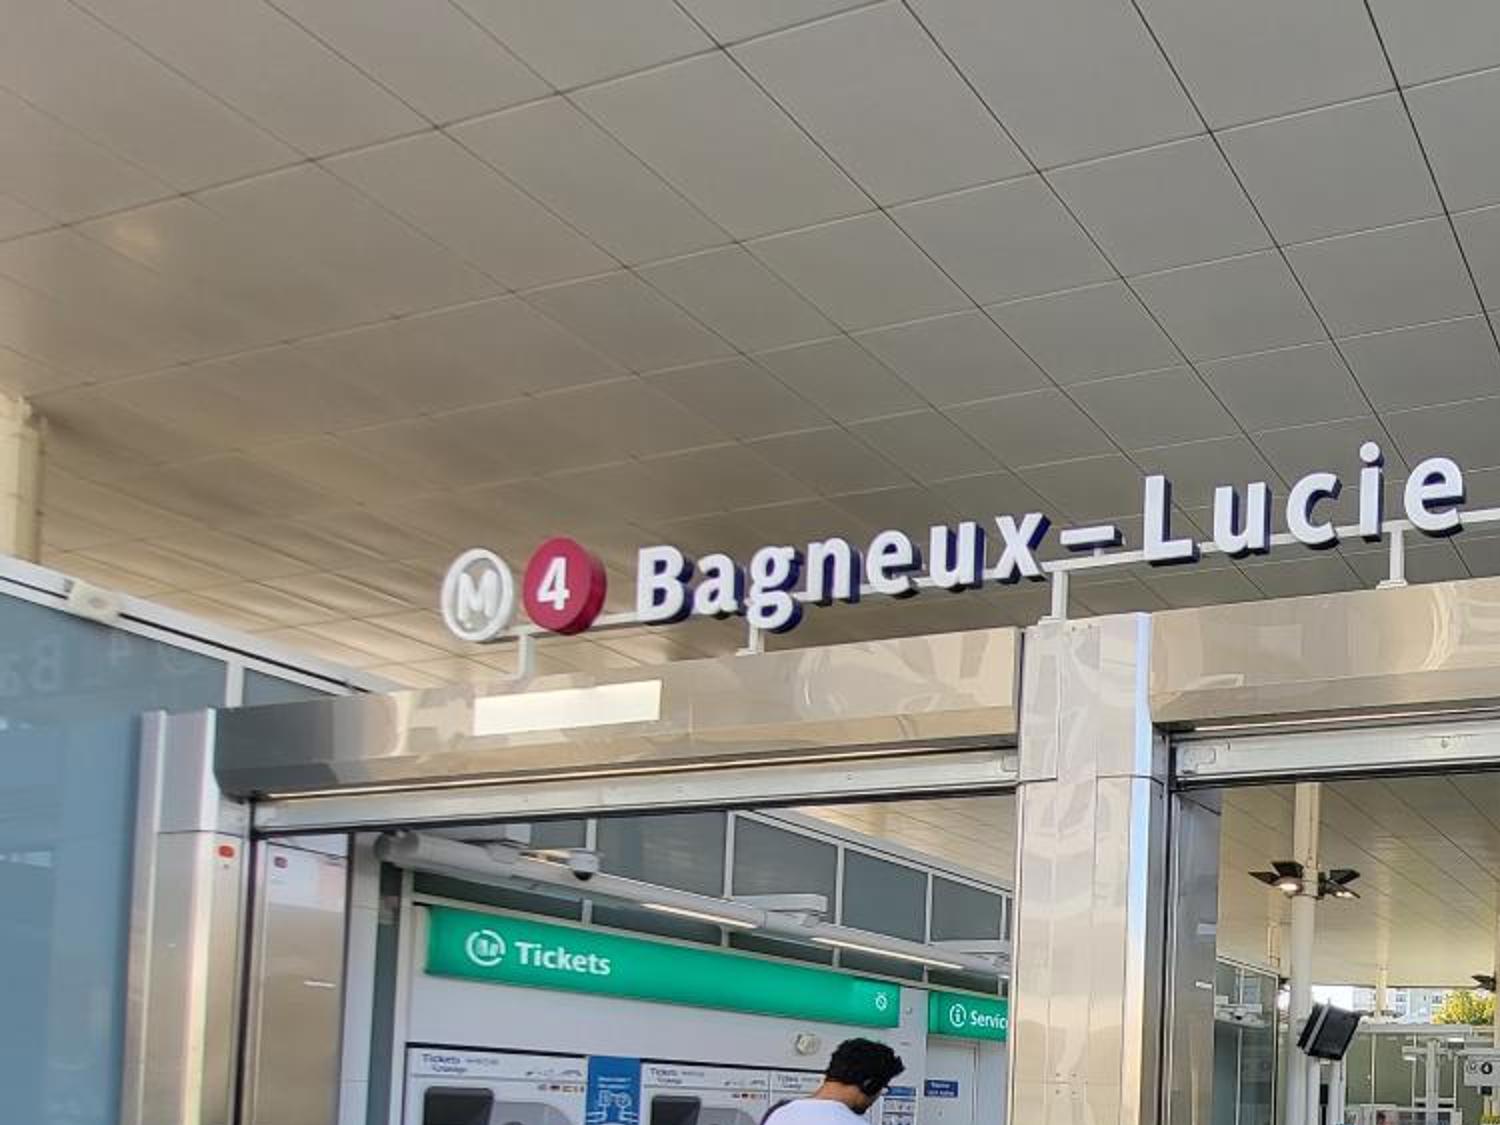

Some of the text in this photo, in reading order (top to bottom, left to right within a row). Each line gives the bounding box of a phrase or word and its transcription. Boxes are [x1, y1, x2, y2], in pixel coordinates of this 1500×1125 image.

[536, 557, 570, 611] 4
[514, 940, 612, 976] Tickets
[970, 1009, 1008, 1030] Servic
